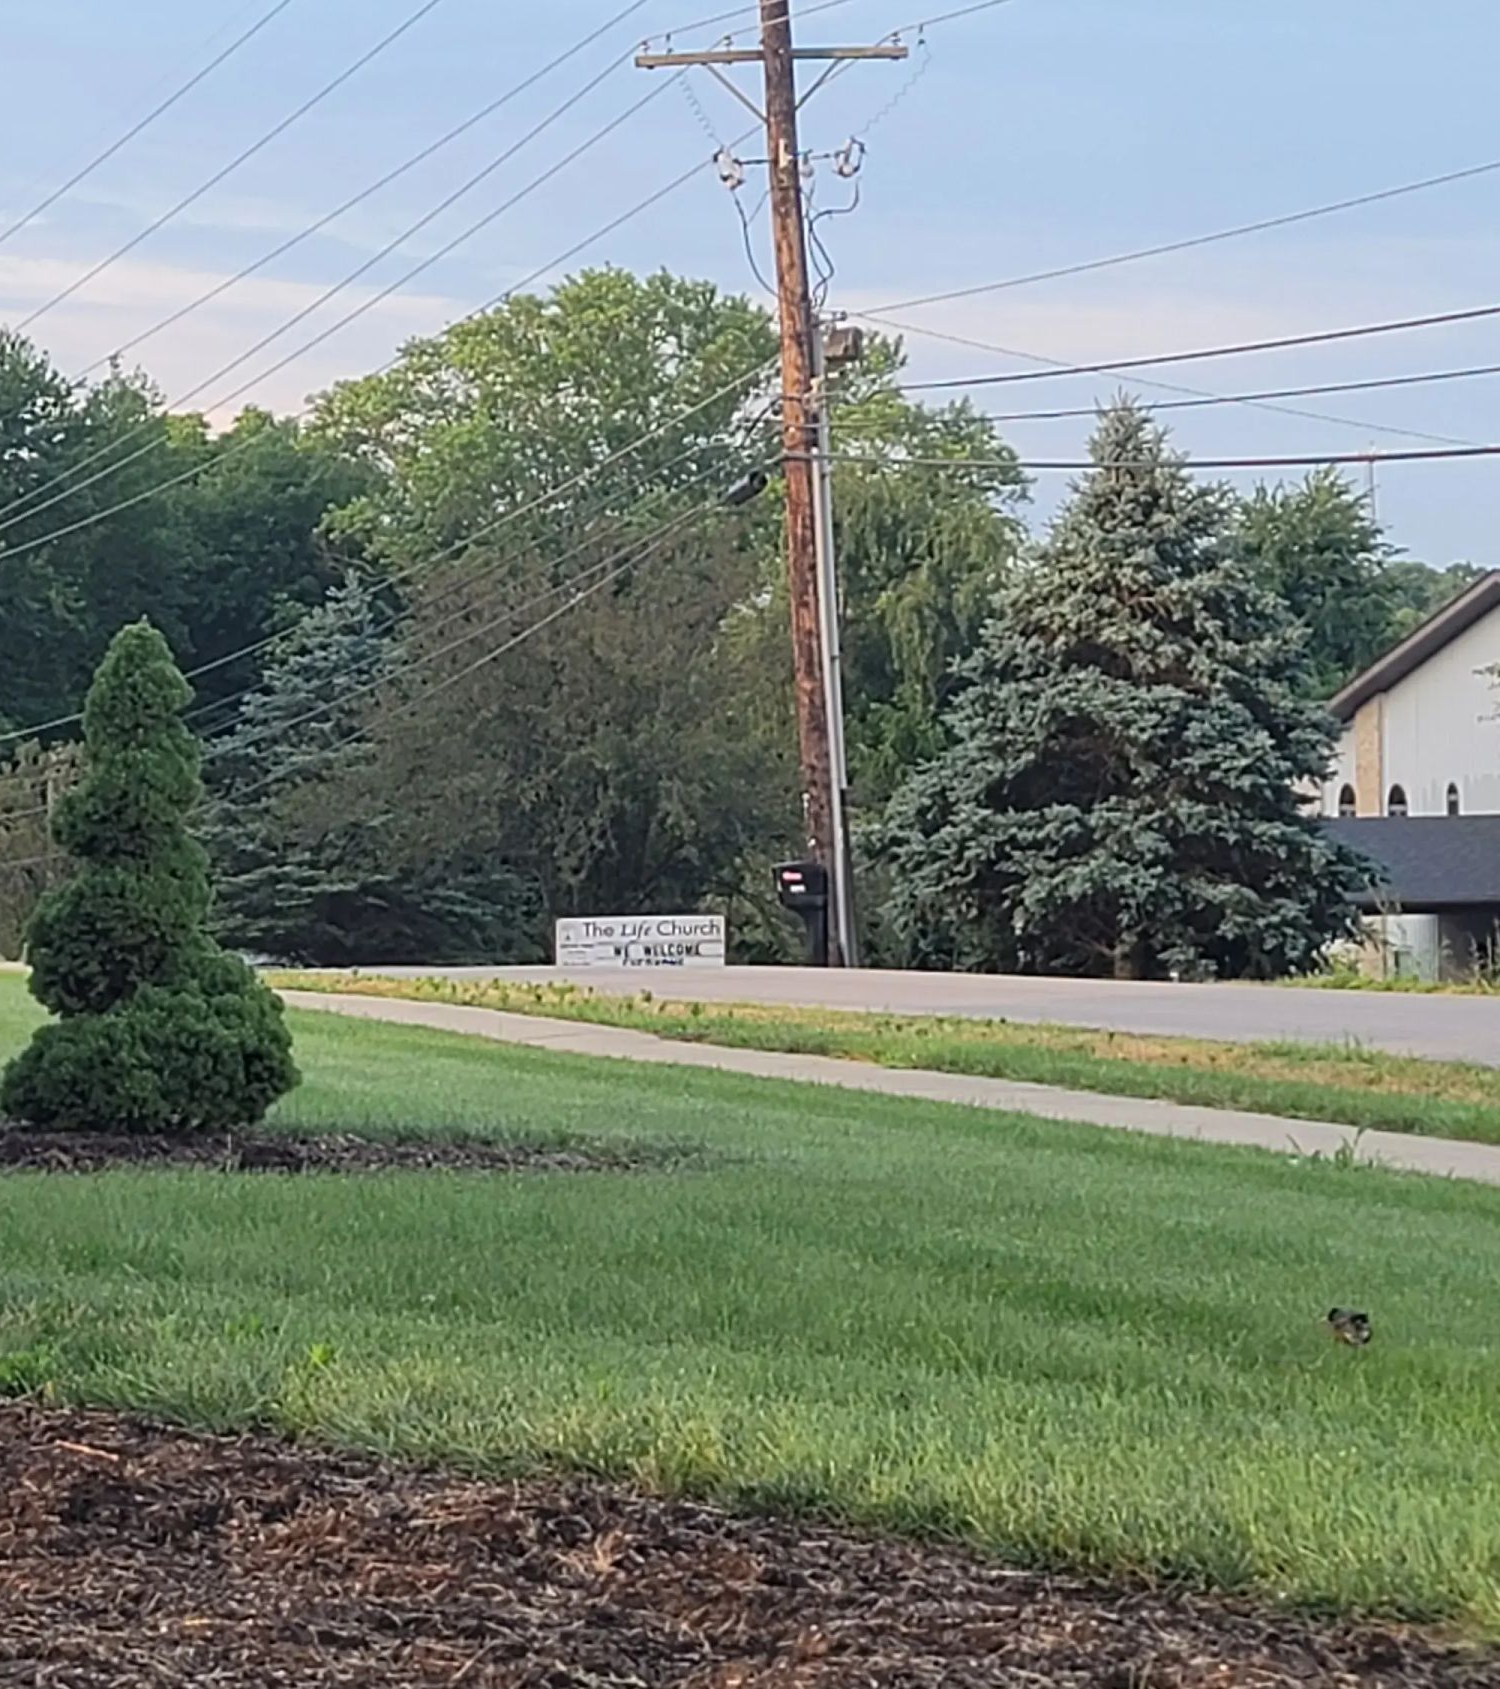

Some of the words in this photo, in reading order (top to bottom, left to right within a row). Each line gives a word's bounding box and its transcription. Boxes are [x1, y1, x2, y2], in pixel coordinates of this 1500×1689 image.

[583, 921, 614, 938] The
[620, 920, 652, 940] Life
[656, 919, 721, 937] Church
